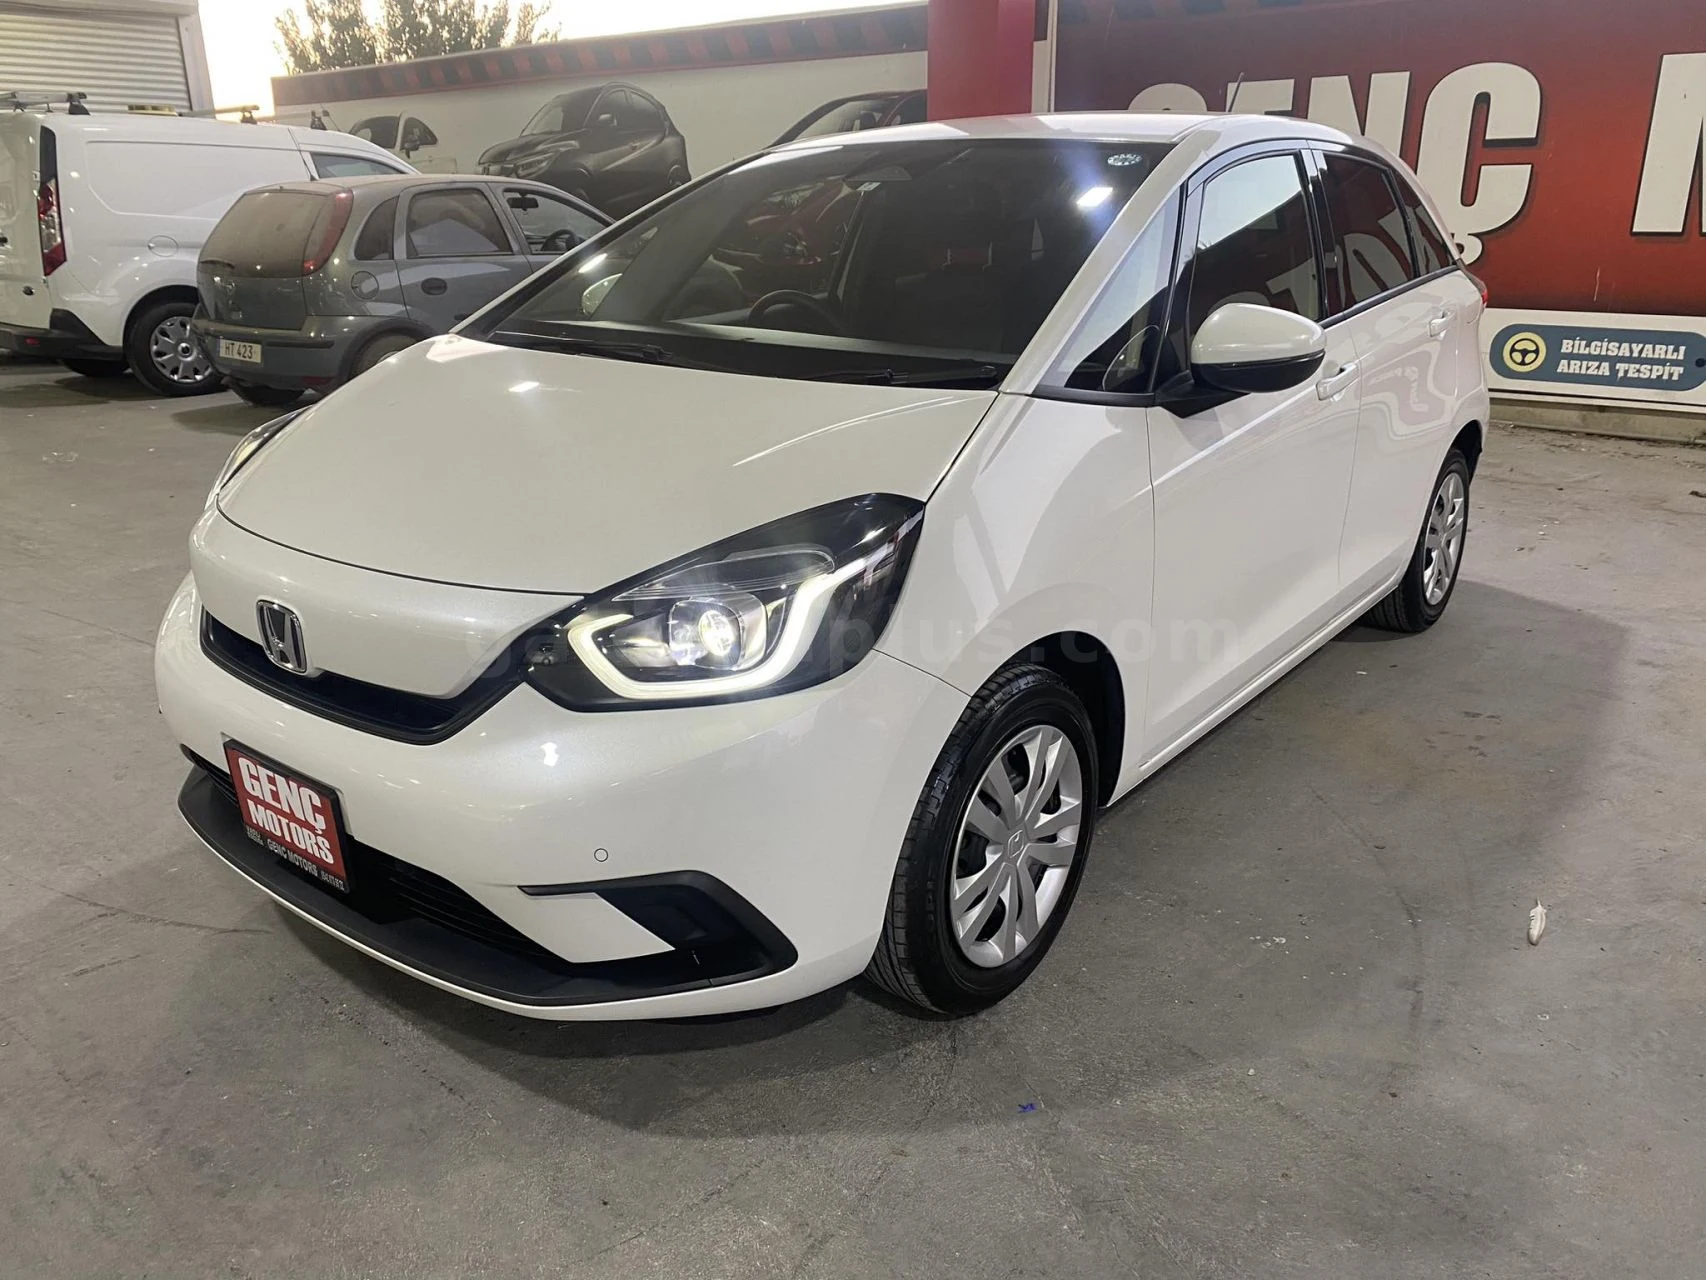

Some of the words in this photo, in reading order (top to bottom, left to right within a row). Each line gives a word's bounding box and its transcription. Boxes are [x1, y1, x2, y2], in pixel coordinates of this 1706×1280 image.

[236, 344, 254, 360] 423
[1560, 337, 1687, 360] BİLGİSAYARLI
[1556, 359, 1610, 376] ARIZA
[1615, 362, 1685, 381] TESPİT
[238, 757, 326, 835] GENÇ
[247, 798, 334, 865] MOTORS
[287, 849, 319, 877] MOTORS
